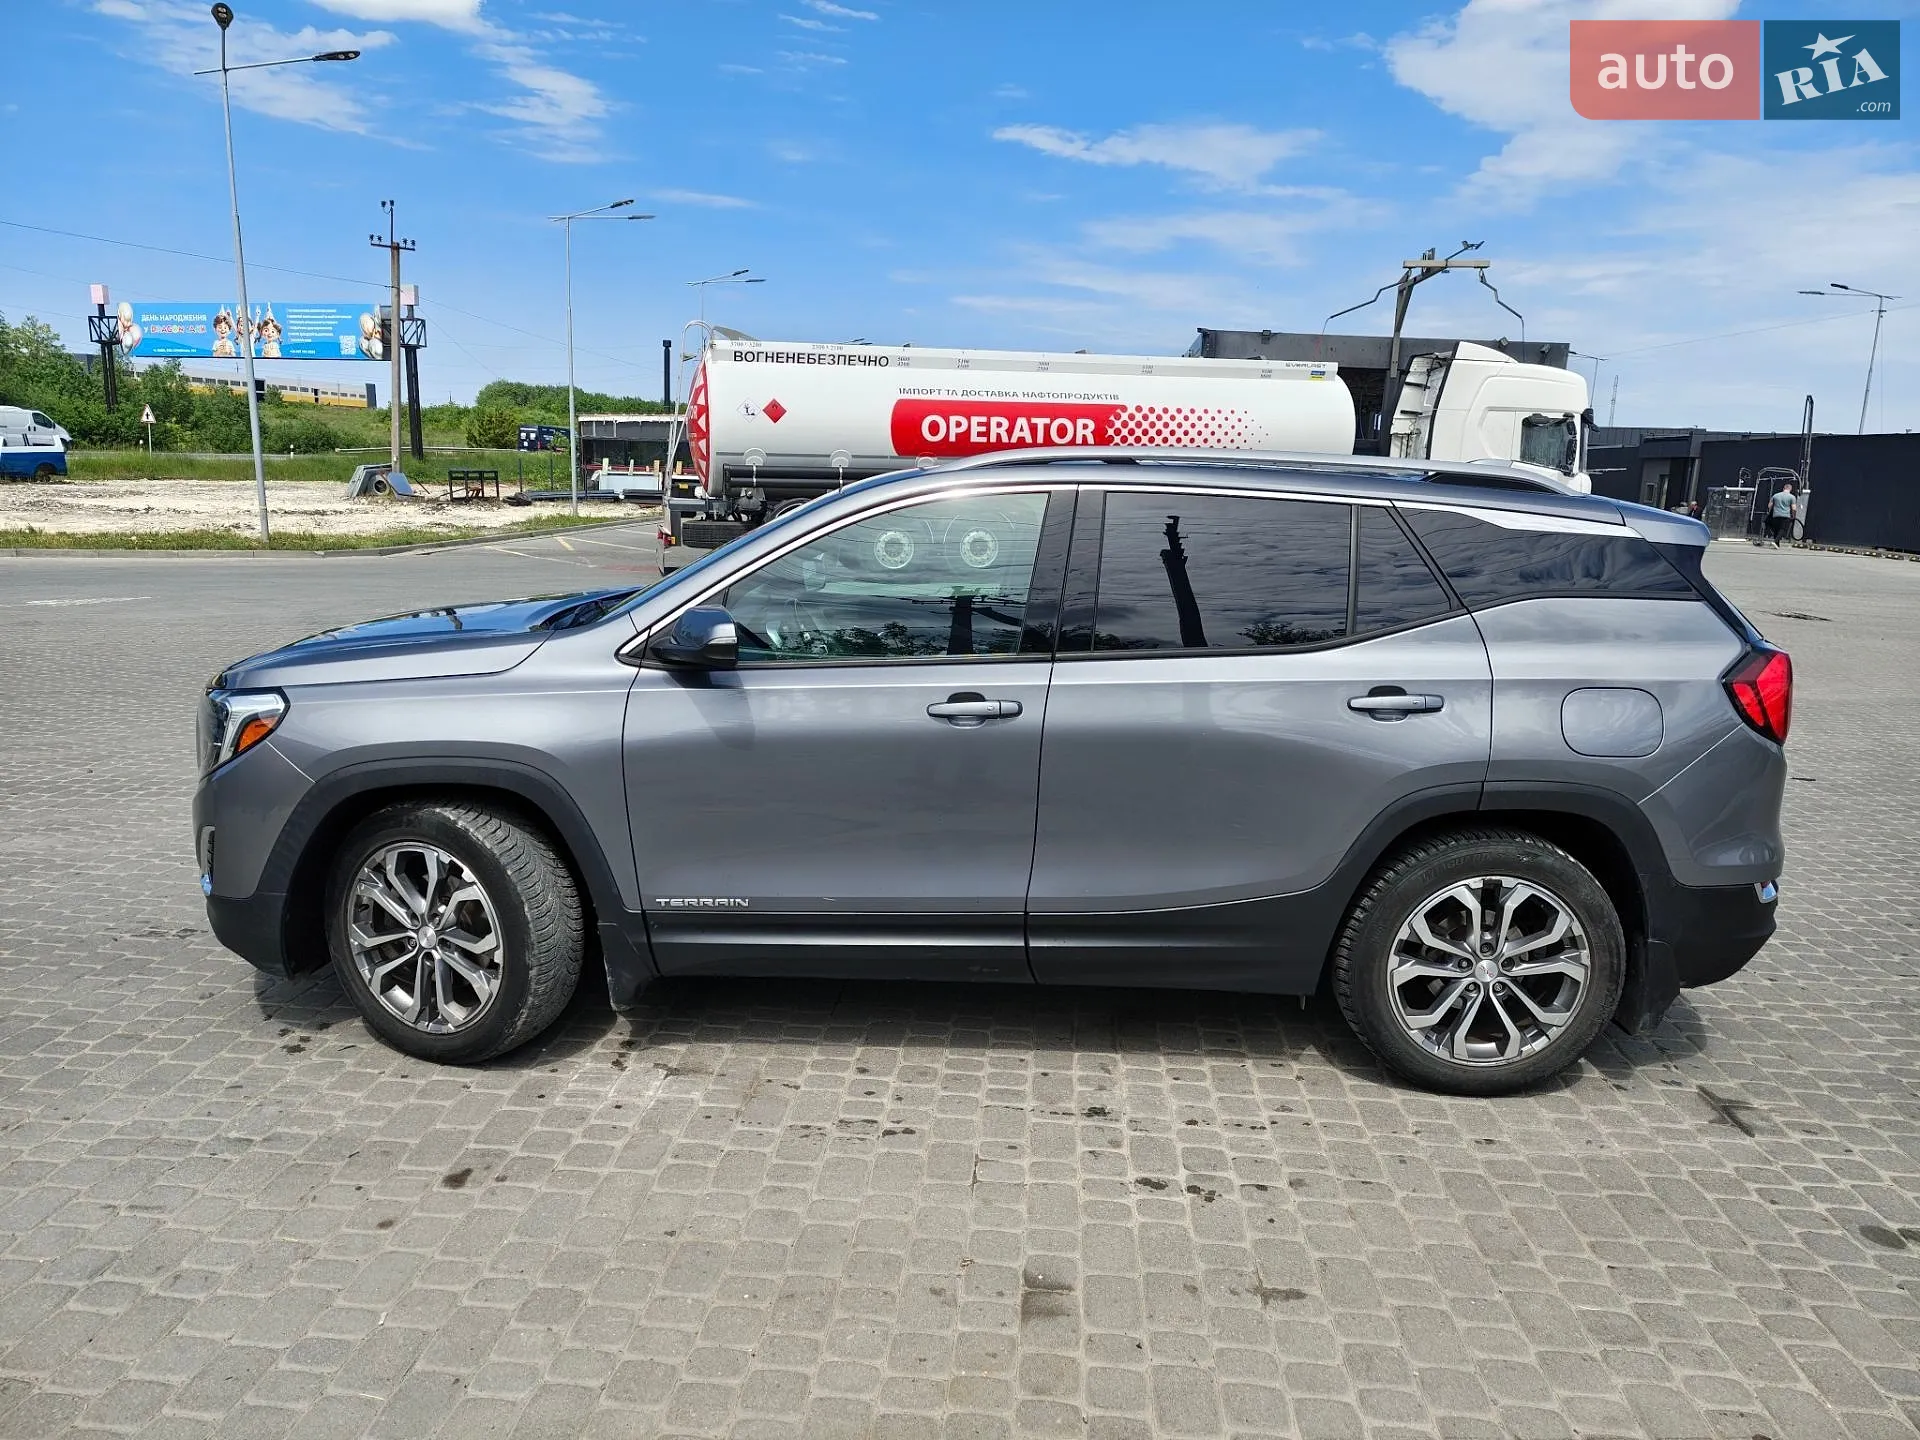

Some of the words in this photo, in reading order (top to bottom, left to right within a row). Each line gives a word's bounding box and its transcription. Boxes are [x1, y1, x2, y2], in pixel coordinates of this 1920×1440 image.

[141, 314, 159, 322] ДЕНЬ
[159, 314, 207, 322] НАРОДЖЕННЯ
[733, 350, 889, 367] ВОГНЕНЕБЕЗПЕЧНО
[899, 387, 942, 396] ІМПОРТ
[947, 389, 958, 397] ТА
[961, 389, 1019, 399] ДОСТАВКА
[1022, 391, 1120, 401] НАФТОПРОДУКТІВ
[921, 414, 1095, 445] OPERATOR
[656, 898, 749, 907] TERRAIN
